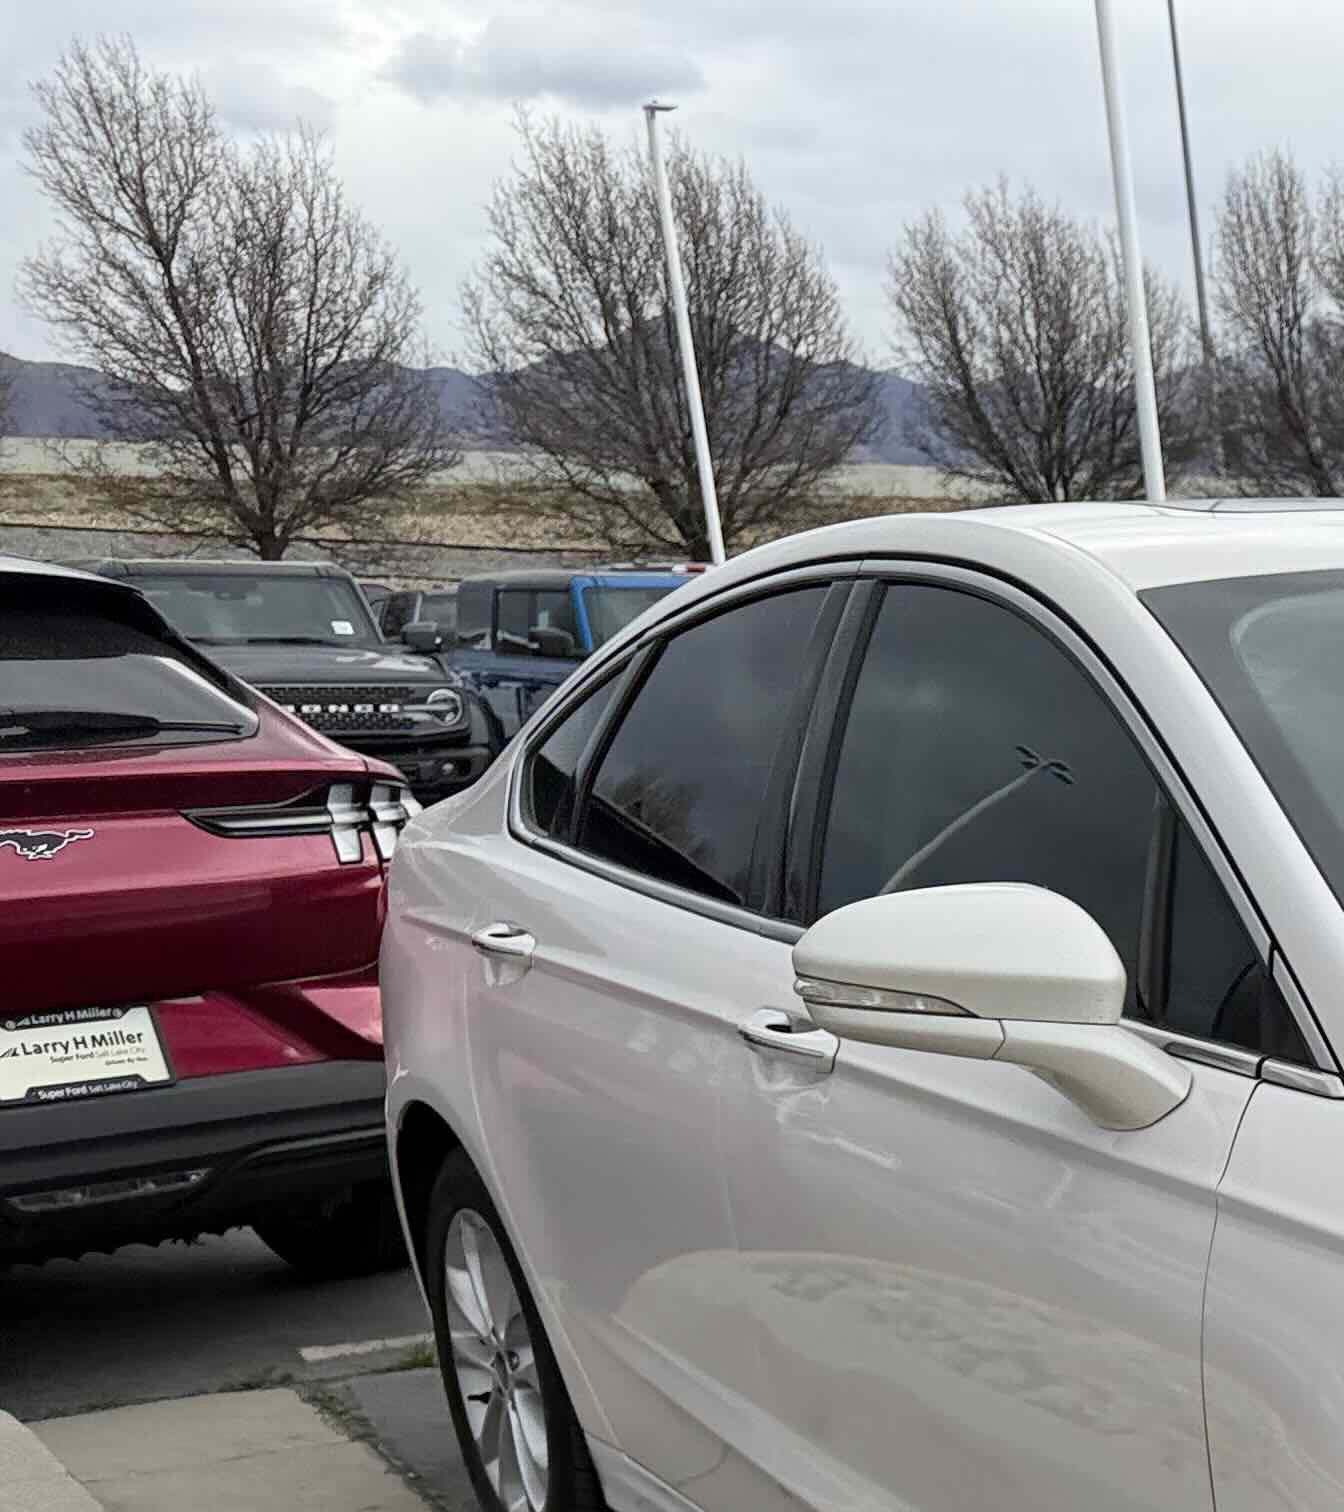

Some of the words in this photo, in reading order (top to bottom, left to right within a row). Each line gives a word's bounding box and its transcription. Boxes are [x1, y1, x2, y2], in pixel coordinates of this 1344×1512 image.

[30, 1012, 64, 1025] Larry
[66, 1010, 76, 1020] H
[76, 1007, 113, 1020] Miller
[21, 1040, 70, 1055] Larry
[74, 1036, 88, 1050] H
[91, 1030, 144, 1048] Miller
[50, 1055, 74, 1064] Super
[76, 1051, 94, 1060] Ford
[38, 1088, 64, 1100] Super
[66, 1085, 88, 1096] Ford
